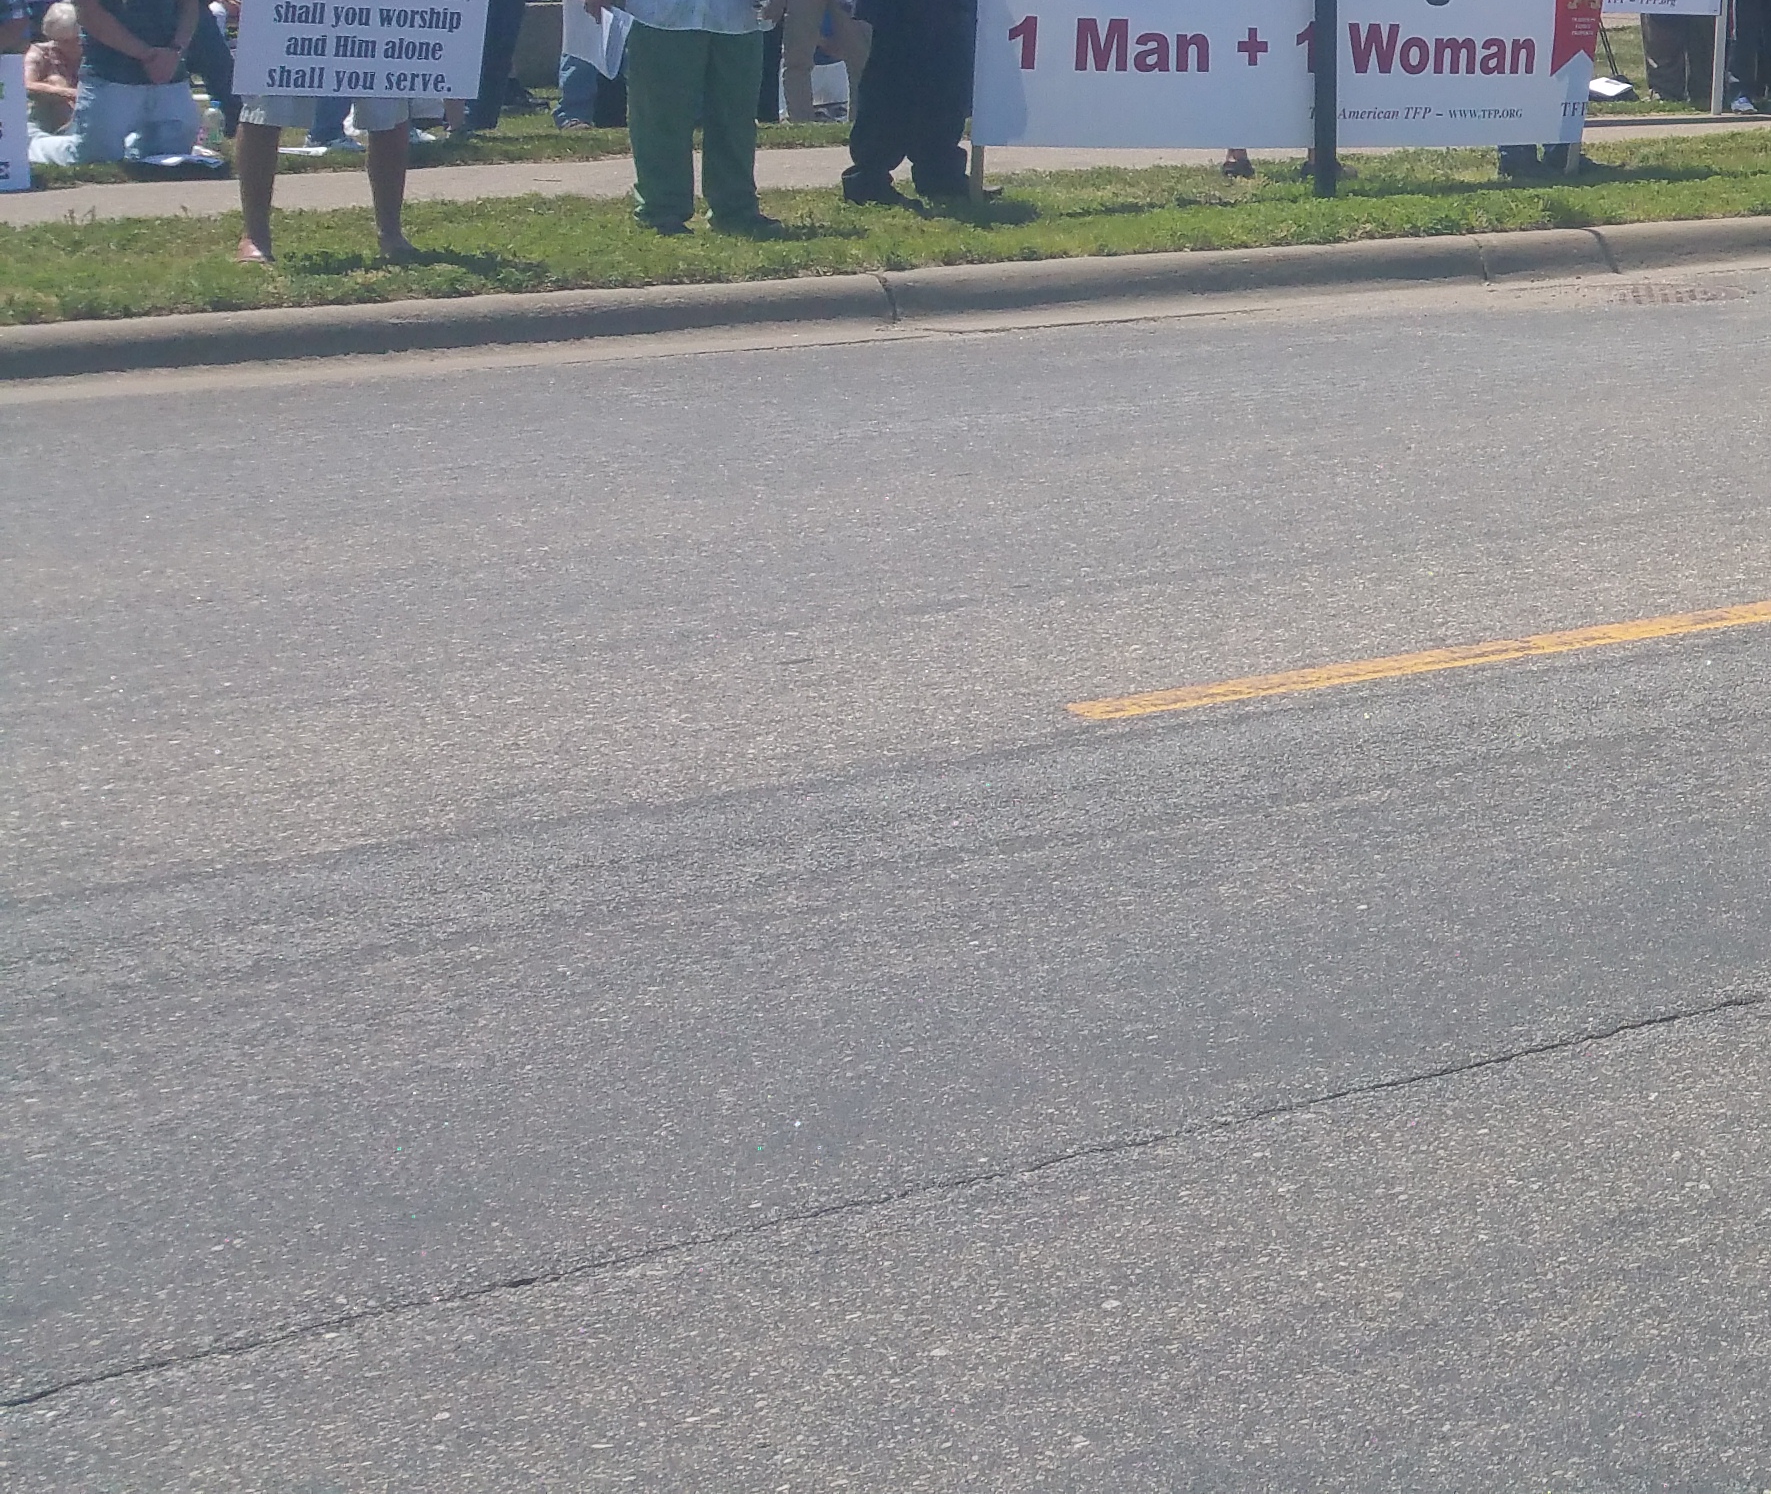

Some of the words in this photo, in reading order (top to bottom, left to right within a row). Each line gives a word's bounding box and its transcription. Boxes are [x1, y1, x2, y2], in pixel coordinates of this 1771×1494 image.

[274, 1, 325, 24] shall
[331, 7, 371, 28] you
[379, 7, 462, 32] worship
[285, 34, 327, 57] and
[333, 36, 376, 58] Him
[384, 38, 444, 60] alone
[1008, 15, 1038, 70] 1
[1074, 17, 1210, 73] Man
[1237, 27, 1268, 66] +
[1348, 22, 1536, 76] Woman
[267, 65, 325, 88] shall
[333, 70, 375, 92] you
[385, 72, 452, 93] serve.
[1337, 107, 1400, 120] American
[1403, 106, 1432, 120] TFP
[1448, 108, 1523, 120] WWW.TFP.ORG
